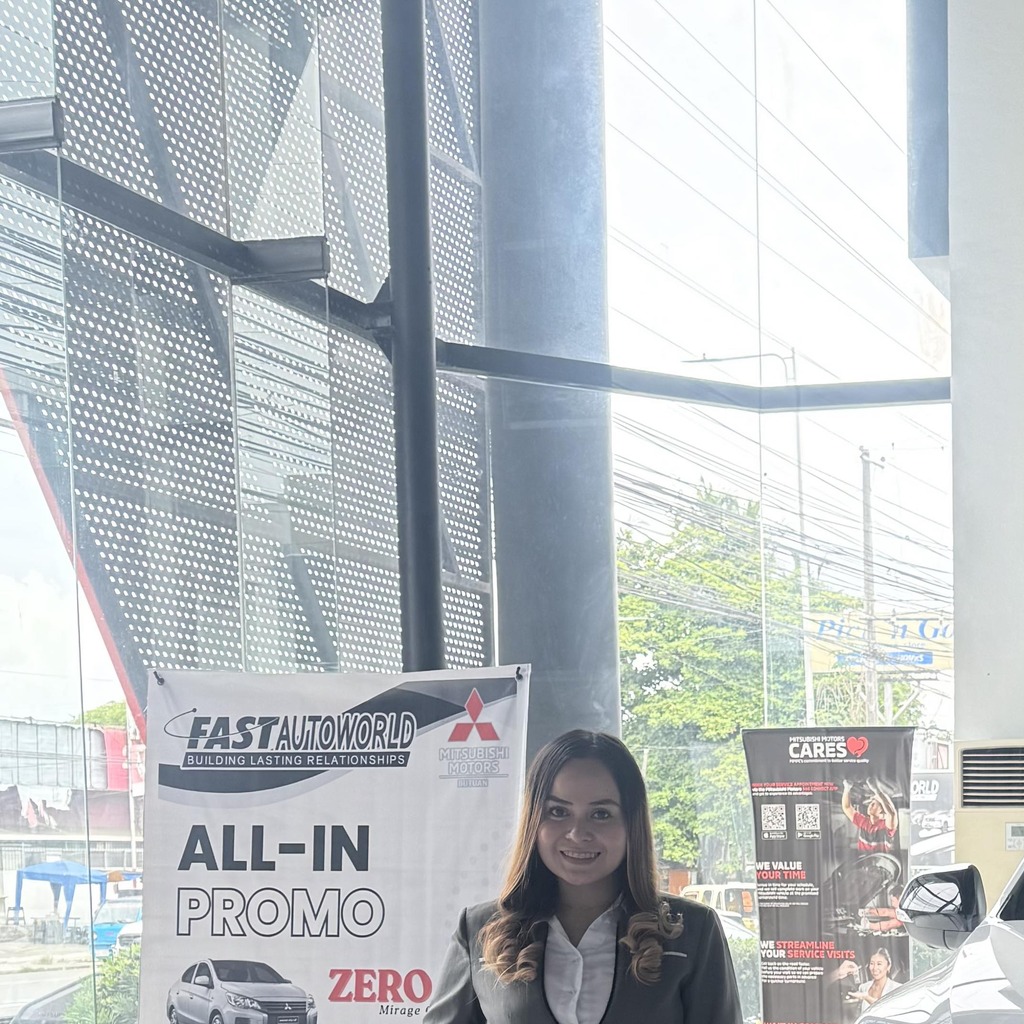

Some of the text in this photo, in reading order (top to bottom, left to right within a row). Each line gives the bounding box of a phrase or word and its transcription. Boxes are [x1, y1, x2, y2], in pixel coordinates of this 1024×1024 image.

[440, 747, 509, 760] MITSUBISHI
[788, 742, 848, 758] CARES
[187, 754, 405, 766] BUILDING LASTING RELATIONSHIPS
[449, 761, 499, 774] MOTORS
[177, 825, 370, 872] ALL-IN
[756, 861, 802, 870] WE VALUE
[756, 870, 806, 880] YOUR TIME
[176, 887, 386, 938] PROMO
[760, 941, 835, 949] WE STREAMLINE
[760, 949, 856, 959] YOUR SERVICE VISITS
[328, 968, 433, 1004] ZERO
[379, 1004, 420, 1017] Mirage
